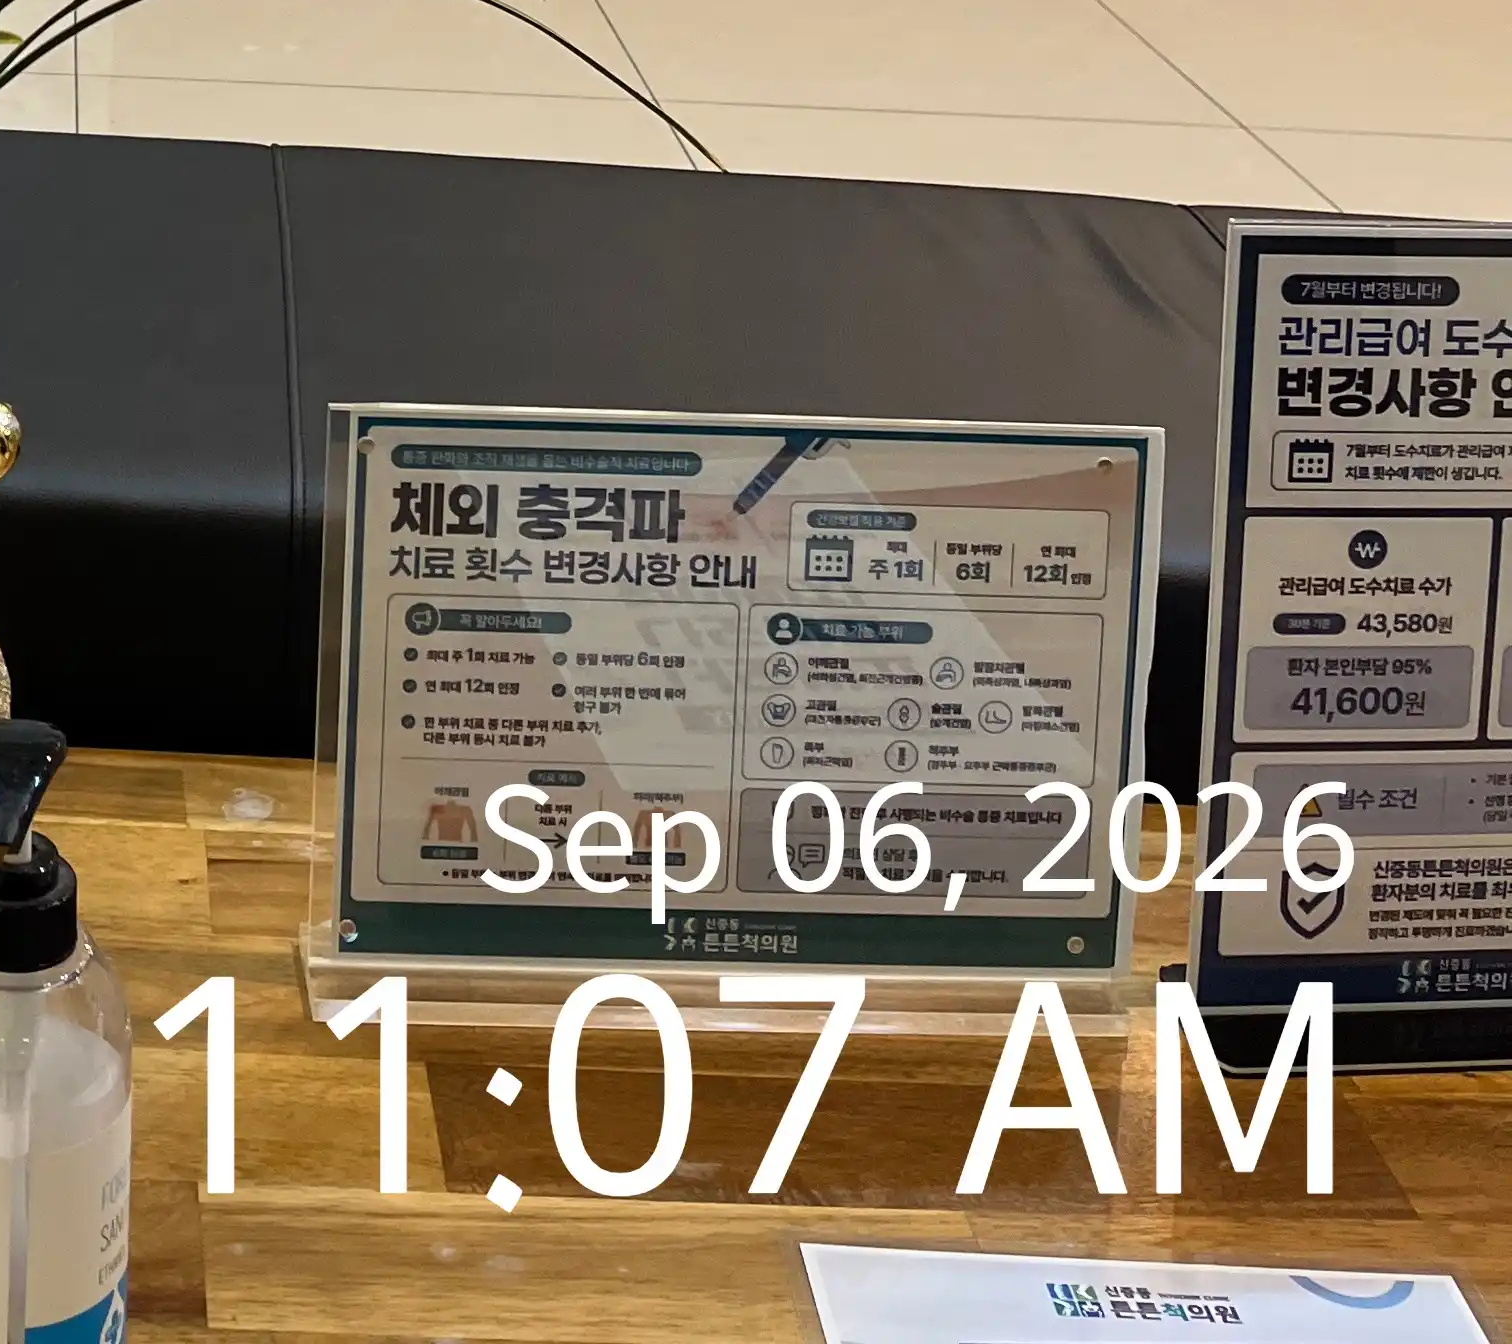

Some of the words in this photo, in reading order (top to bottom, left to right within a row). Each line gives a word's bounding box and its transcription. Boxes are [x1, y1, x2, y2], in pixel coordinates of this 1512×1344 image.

[1301, 281, 1356, 299] 7월부터
[1360, 282, 1442, 299] 변경됩니다!
[1277, 317, 1431, 357] 관리급여
[1277, 367, 1477, 418] 변경사항
[1346, 443, 1390, 458] 7월부터
[1345, 467, 1369, 480] 치료
[1451, 467, 1502, 481] 생깁니다.
[391, 482, 499, 538] 체외
[517, 484, 686, 543] 충격파
[390, 546, 455, 580] 치료
[466, 547, 533, 583] 횟수
[544, 550, 680, 586] 변경사항
[690, 554, 757, 589] 안내
[869, 559, 888, 579] 주
[894, 560, 923, 581] 1회
[956, 562, 990, 583] 6회
[1024, 563, 1067, 584] 12회
[1278, 578, 1344, 596] 관리급여
[1348, 578, 1414, 596] 도수치료
[1418, 578, 1451, 596] 수가
[1357, 614, 1453, 637] 43,580원
[452, 651, 463, 662] 주
[467, 649, 485, 663] 1회
[489, 652, 510, 663] 치료
[513, 653, 535, 664] 가능
[637, 653, 660, 667] 6회
[1288, 658, 1319, 676] 환자
[1323, 659, 1387, 676] 본인부담
[1392, 658, 1432, 675] 95%
[464, 679, 494, 693] 12회
[498, 683, 519, 695] 인정
[599, 687, 622, 698] 부위
[625, 687, 635, 698] 한
[1291, 687, 1425, 721] 41,600원
[424, 717, 435, 729] 한
[438, 717, 460, 729] 부위
[463, 718, 485, 730] 치료
[502, 719, 523, 731] 다른
[527, 720, 549, 731] 부위
[552, 721, 574, 732] 치료
[423, 733, 445, 744] 다른
[449, 733, 470, 745] 부위
[498, 734, 520, 746] 치료
[1379, 788, 1417, 810] 조건
[1372, 883, 1435, 902] 환자분의
[1440, 882, 1487, 900] 치료를
[705, 918, 739, 931] 신중동
[703, 934, 797, 954] 튼튼척의원
[1104, 1285, 1150, 1298] 신중동
[1110, 1301, 1243, 1325] 튼튼척의원
